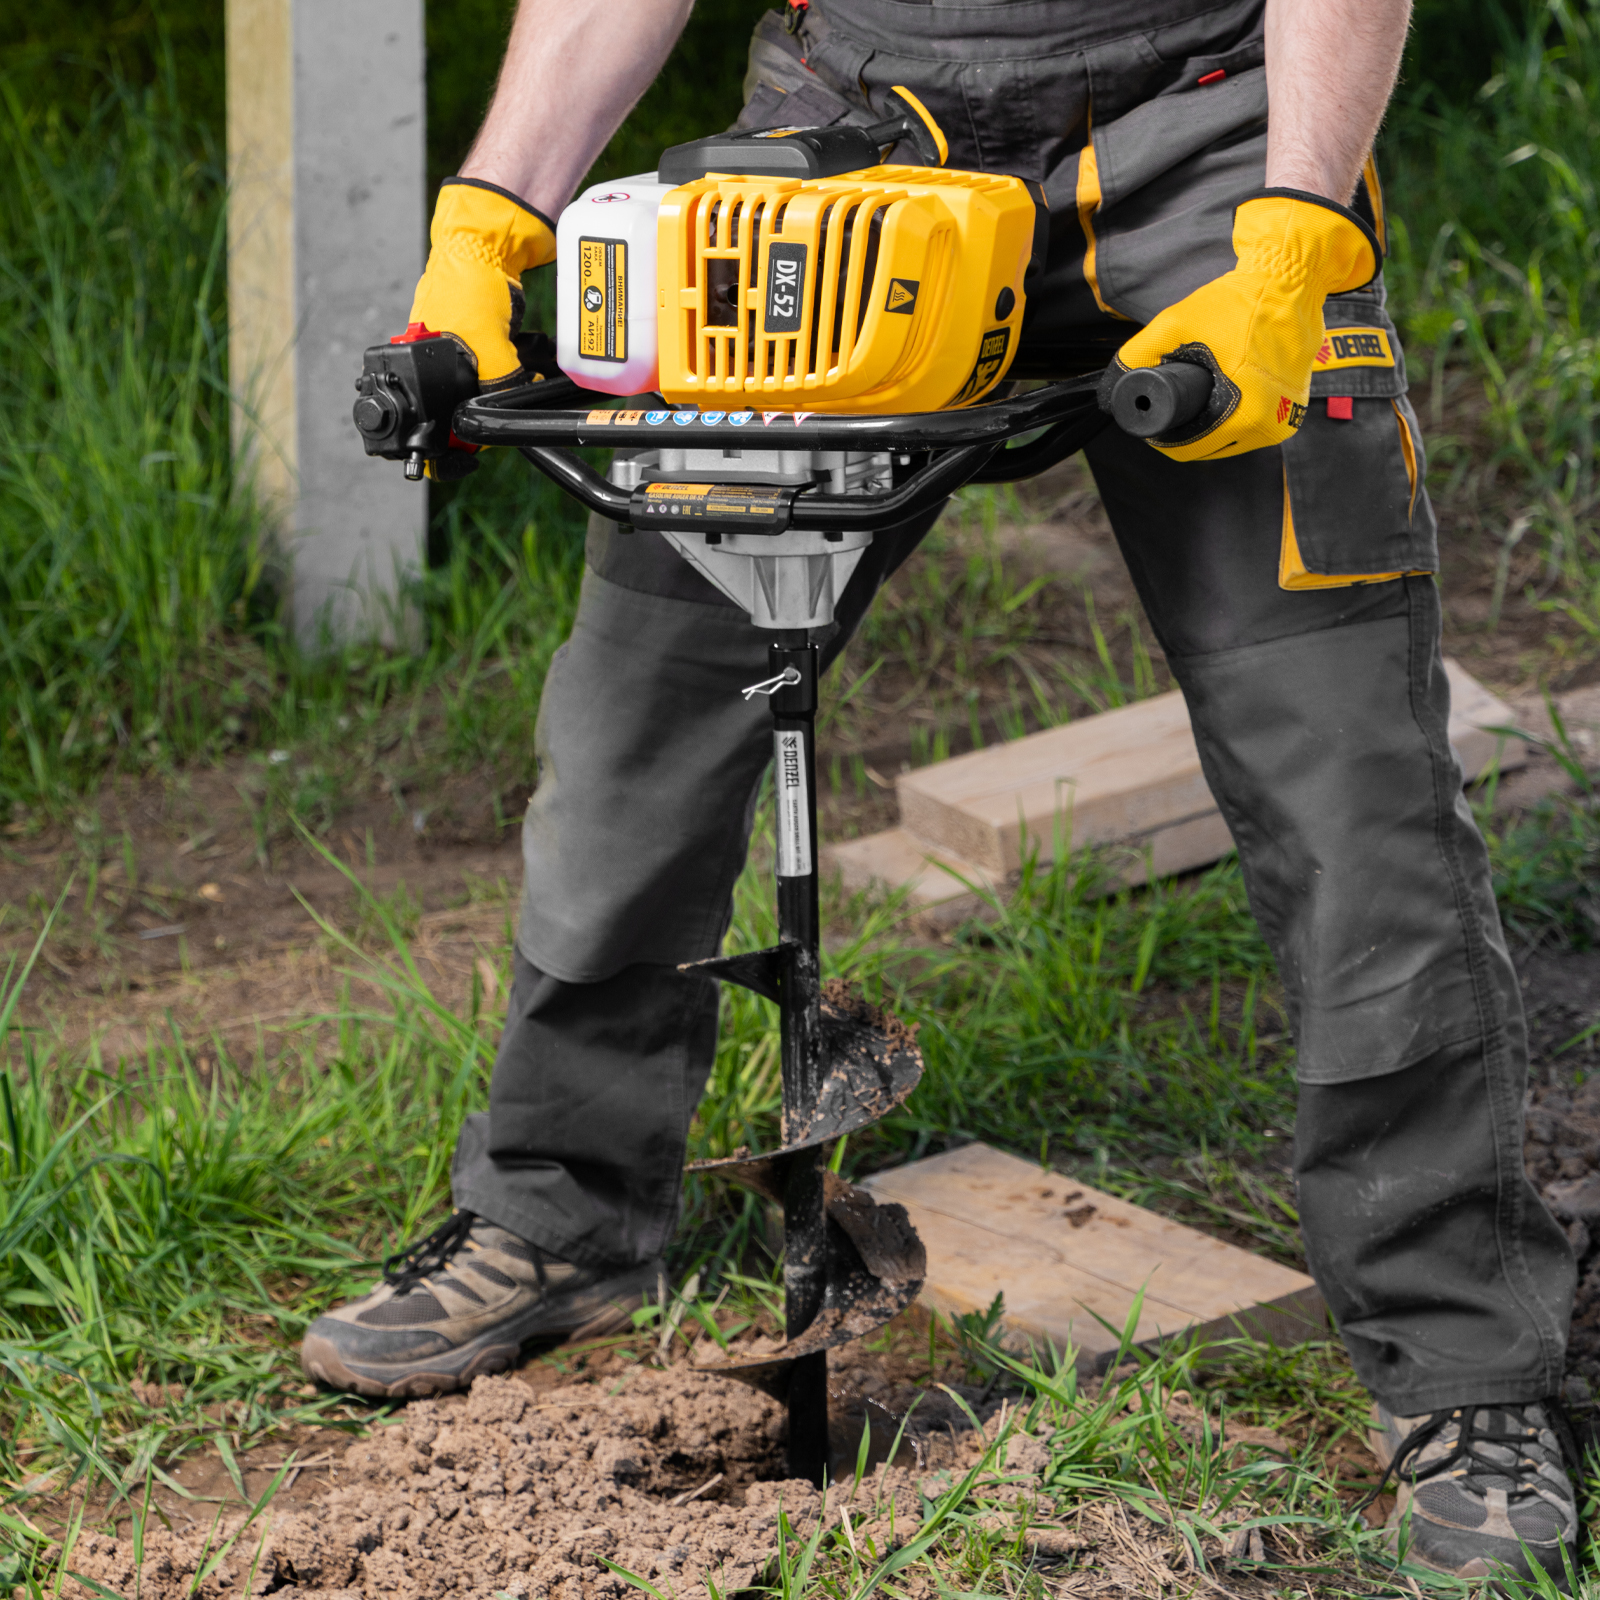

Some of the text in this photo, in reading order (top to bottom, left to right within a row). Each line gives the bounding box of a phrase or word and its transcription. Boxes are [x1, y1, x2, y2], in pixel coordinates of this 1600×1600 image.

[583, 246, 592, 277] 1200
[773, 259, 797, 318] DX-52
[981, 334, 1005, 359] DENZEL
[783, 750, 800, 790] DENZEL
